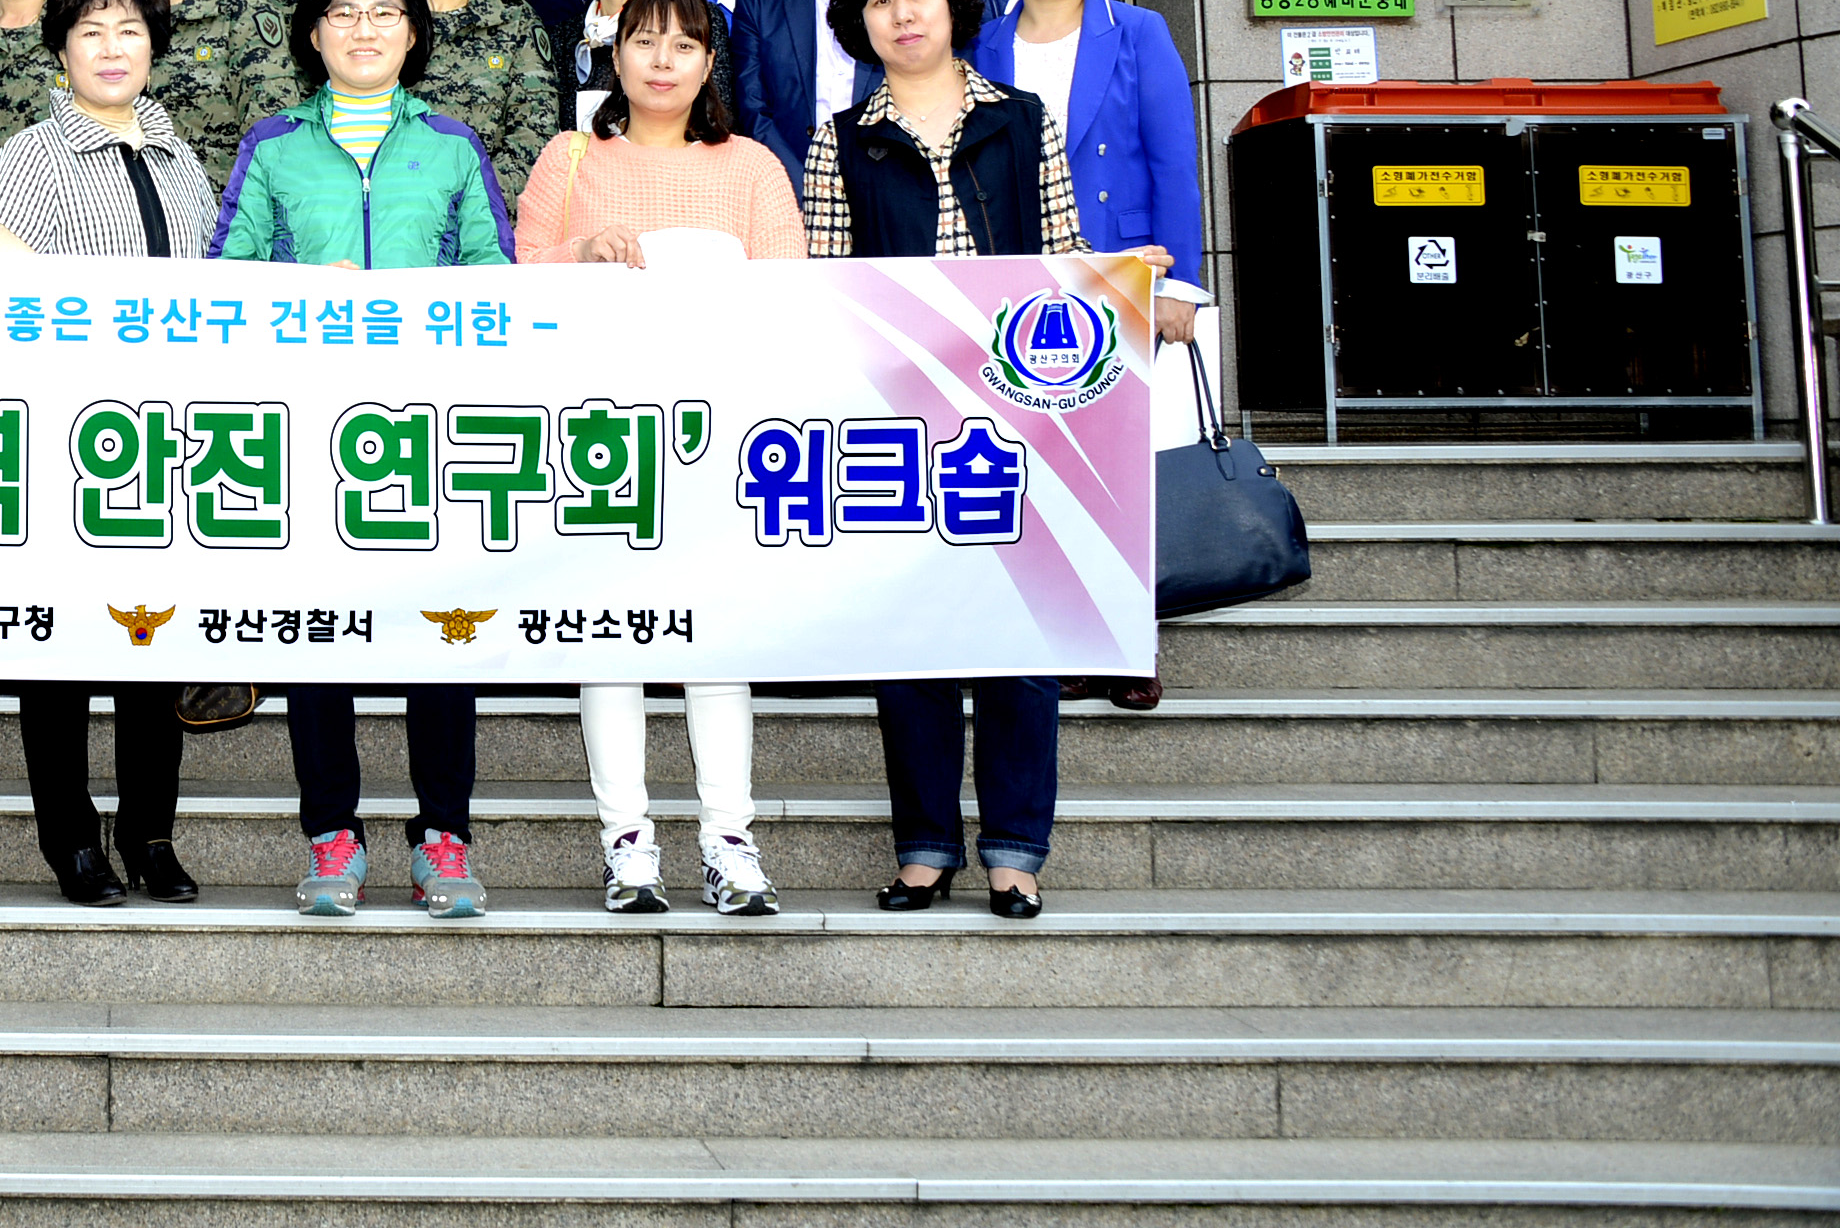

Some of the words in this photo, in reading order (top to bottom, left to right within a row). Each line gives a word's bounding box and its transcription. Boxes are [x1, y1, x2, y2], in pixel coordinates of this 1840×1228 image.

[1380, 171, 1477, 182] 소형폐가전수거함
[1586, 171, 1683, 182] 소형폐가전수거함
[3, 296, 93, 343] 좋은
[113, 297, 248, 345] 광산구
[269, 299, 404, 346] 건설을
[424, 300, 512, 347] 위한
[1029, 353, 1080, 365] 광산구의회
[982, 366, 1076, 410] GWANGSAN-GU
[1078, 363, 1125, 404] COUNCIL
[76, 409, 283, 541] 안전
[743, 425, 1022, 538] 워크숍
[198, 607, 373, 645] 광산경찰서
[518, 607, 693, 646] 광산소방서
